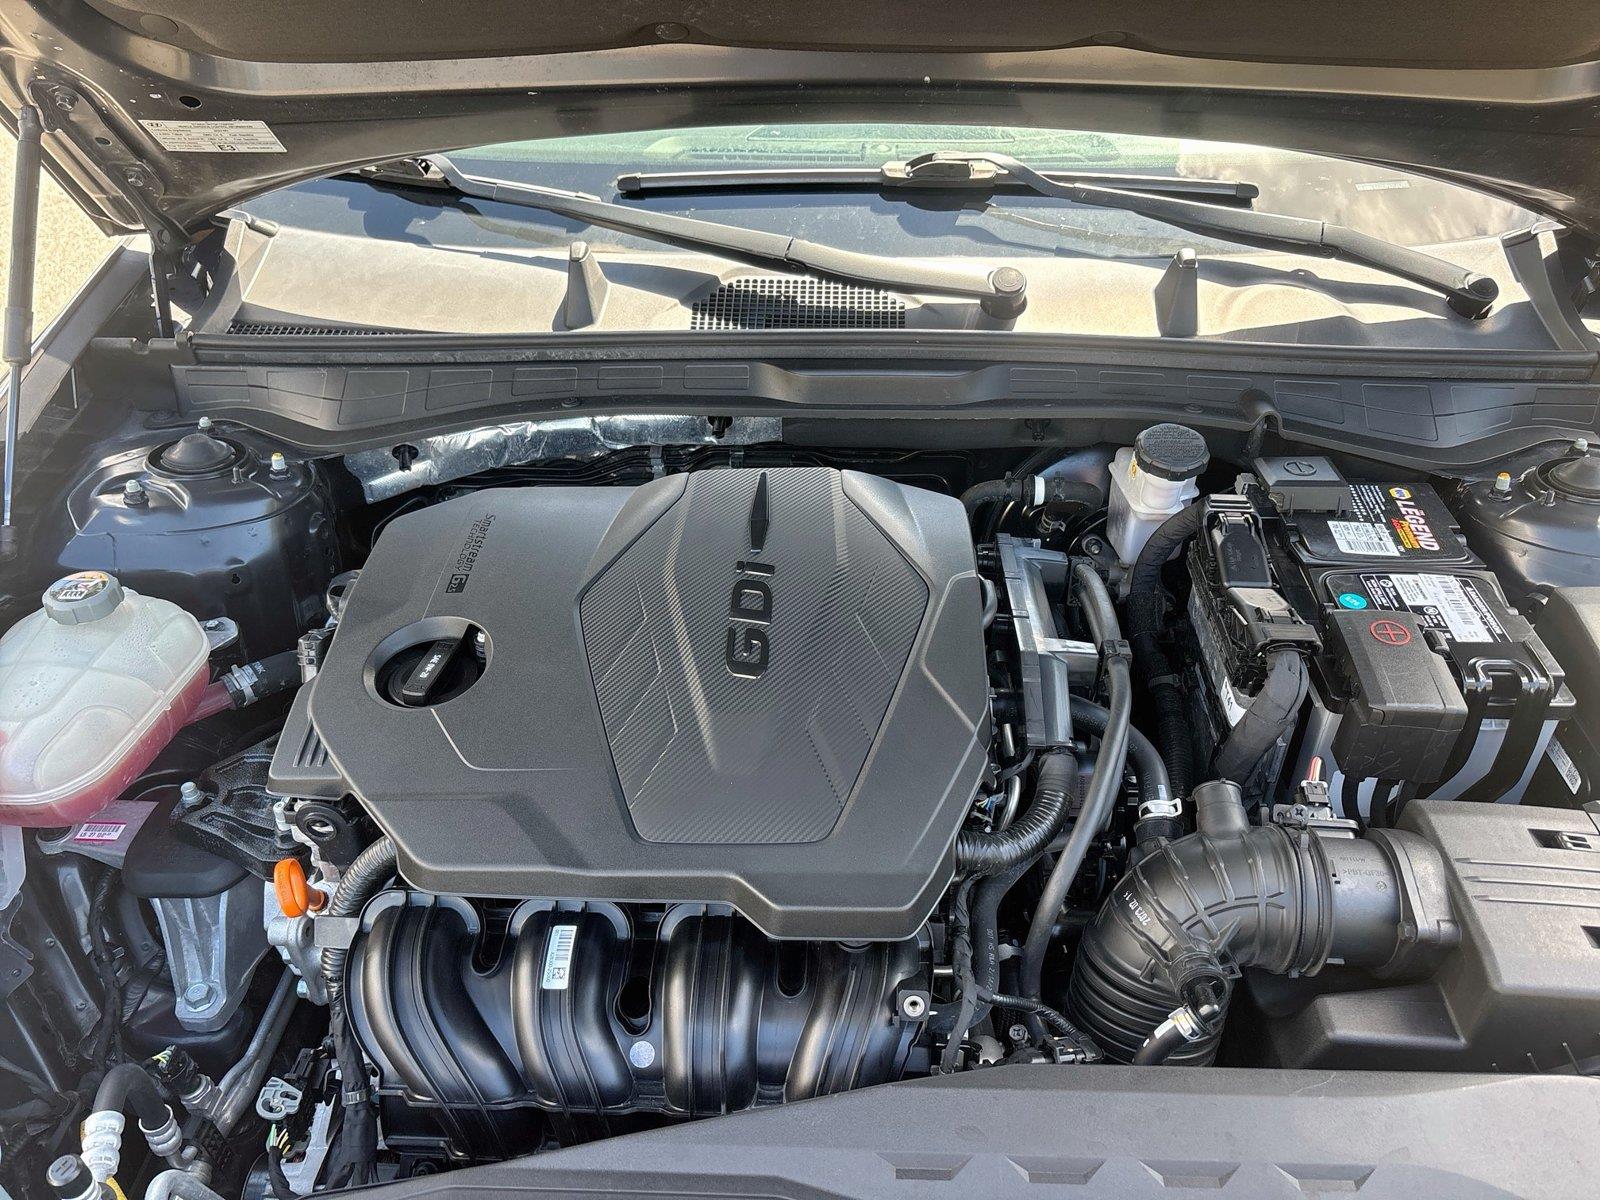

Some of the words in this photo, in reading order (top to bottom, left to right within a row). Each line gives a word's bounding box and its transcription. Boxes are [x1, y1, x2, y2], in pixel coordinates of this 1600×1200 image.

[454, 519, 482, 572] TECHNOLOGY
[463, 512, 496, 572] Smartstream
[725, 560, 776, 680] GDi
